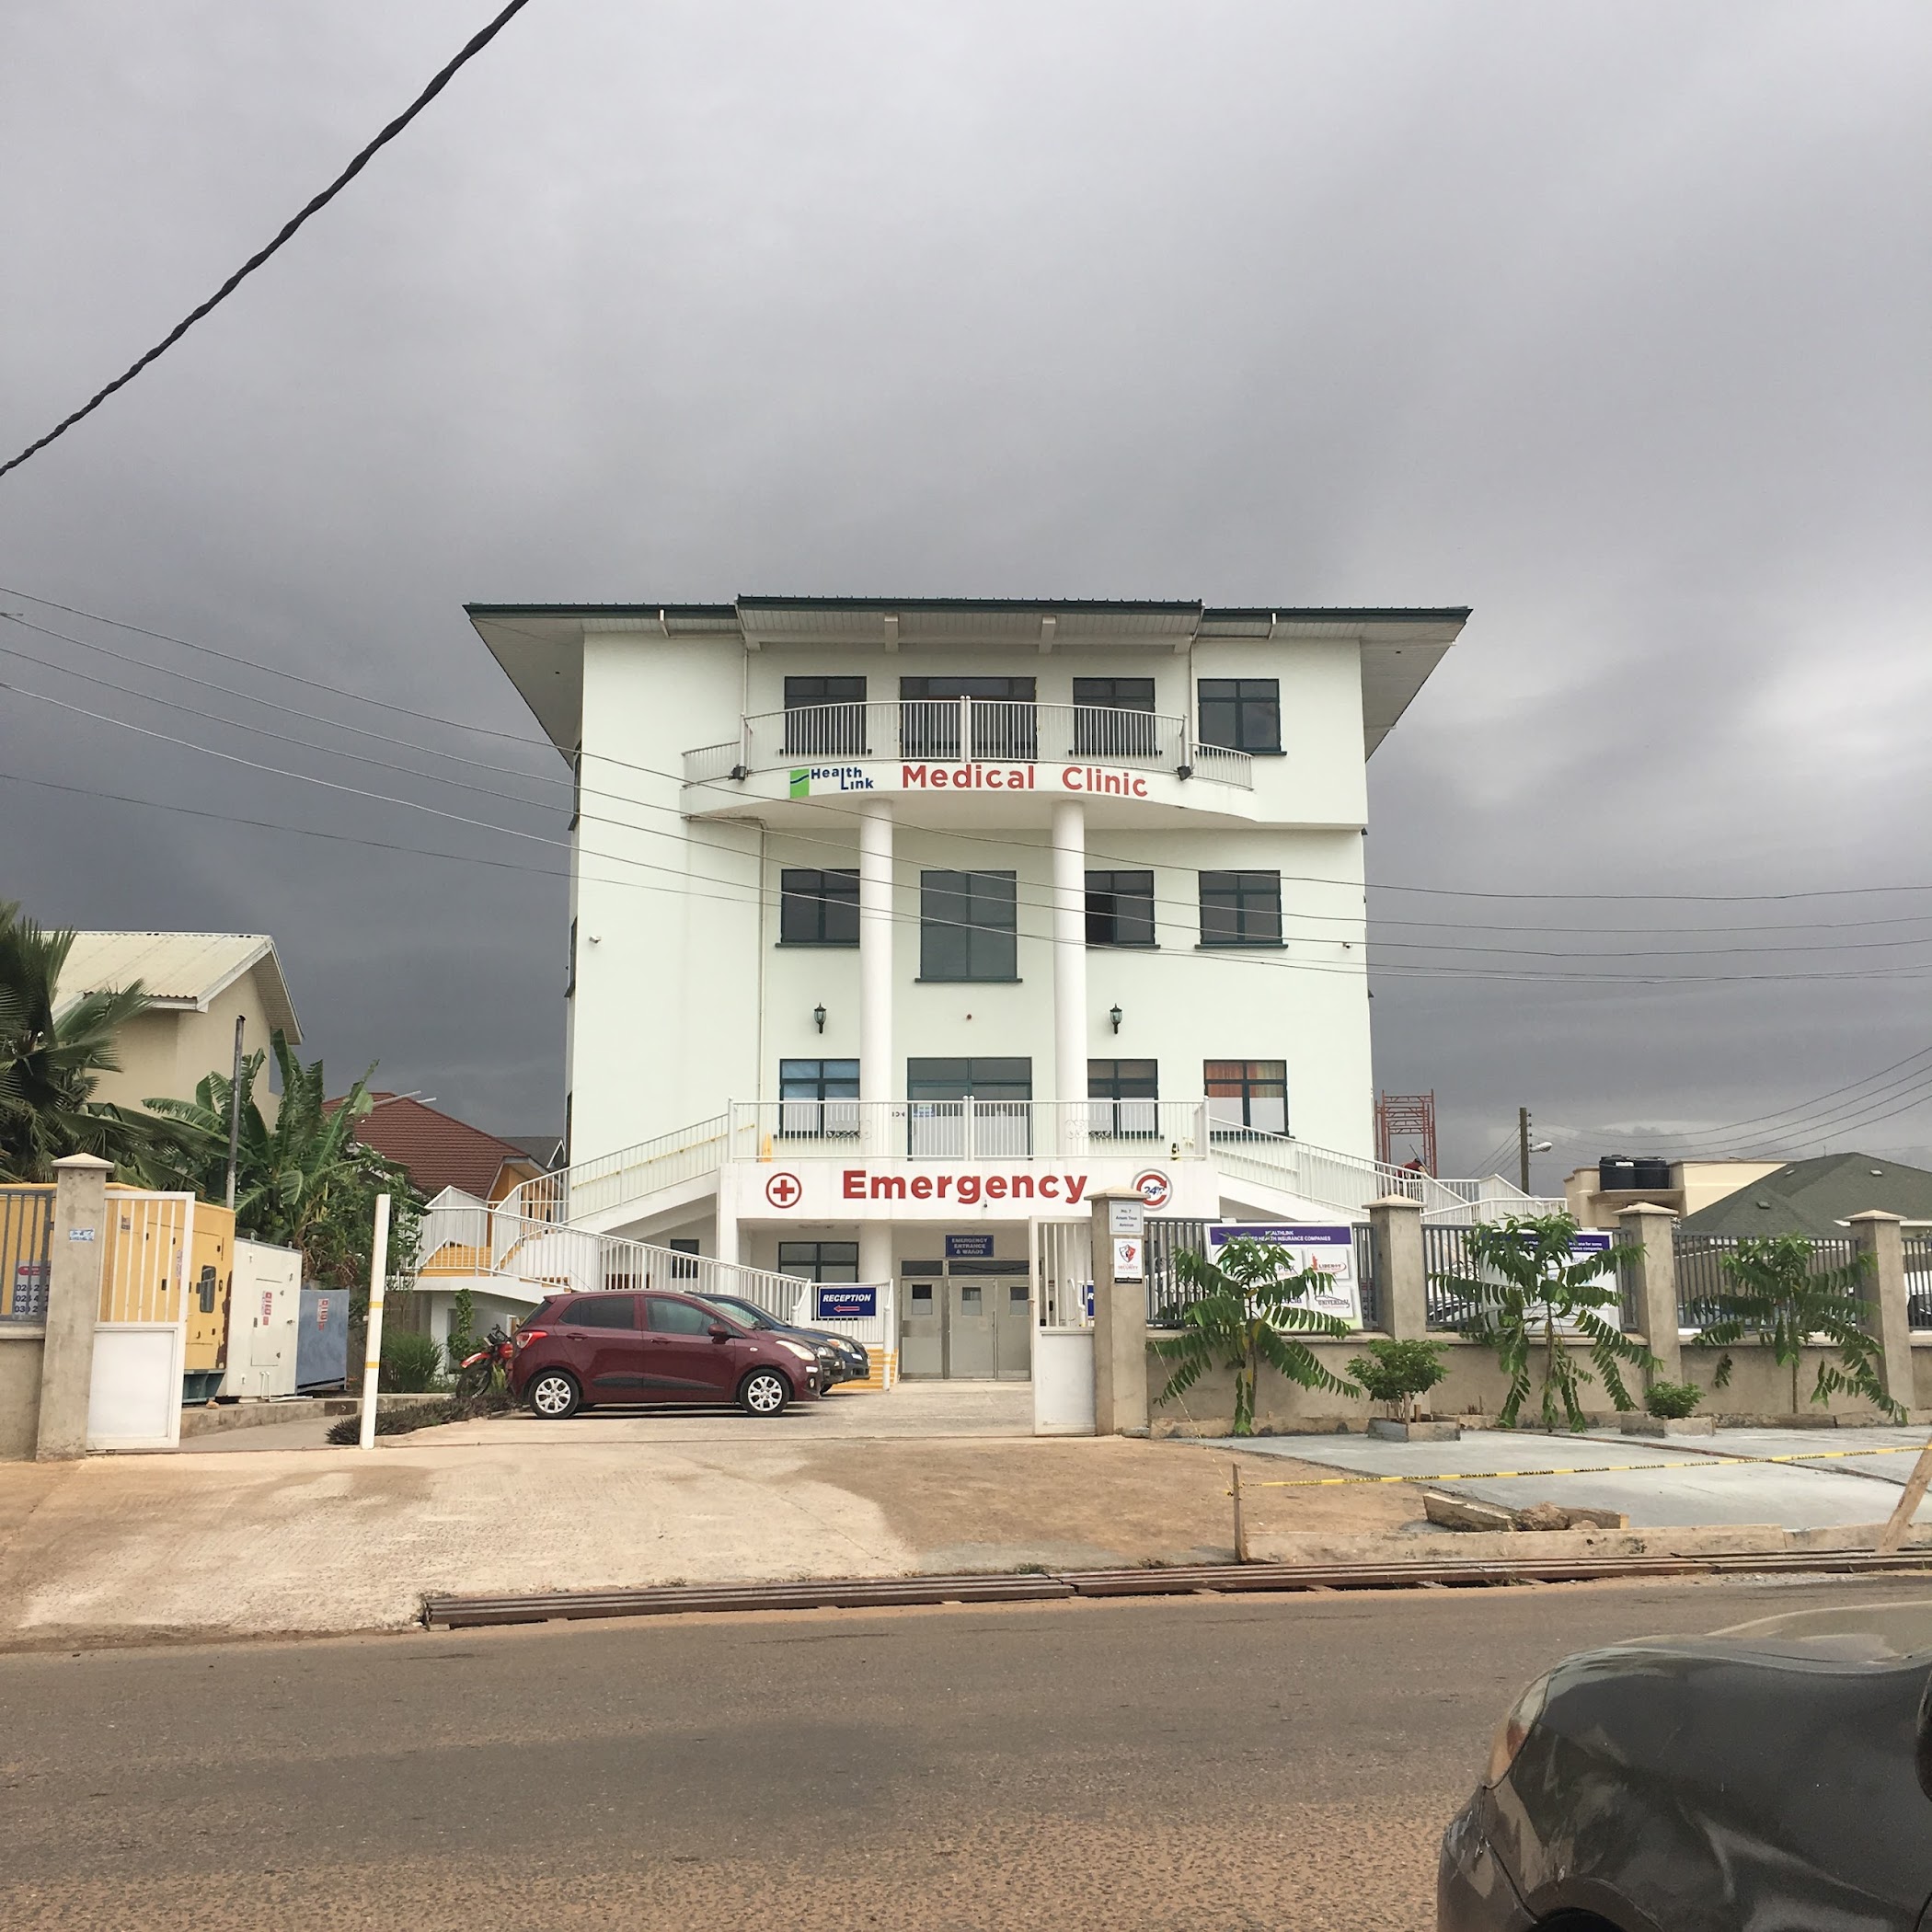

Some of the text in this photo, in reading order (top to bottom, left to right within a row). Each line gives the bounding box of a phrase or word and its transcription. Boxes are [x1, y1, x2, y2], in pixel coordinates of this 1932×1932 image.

[811, 767, 863, 780] Health
[840, 777, 874, 790] Link
[903, 765, 1148, 797] Medical Clinic
[843, 1170, 1087, 1204] Emergency
[822, 1294, 872, 1303] RECEPTION
